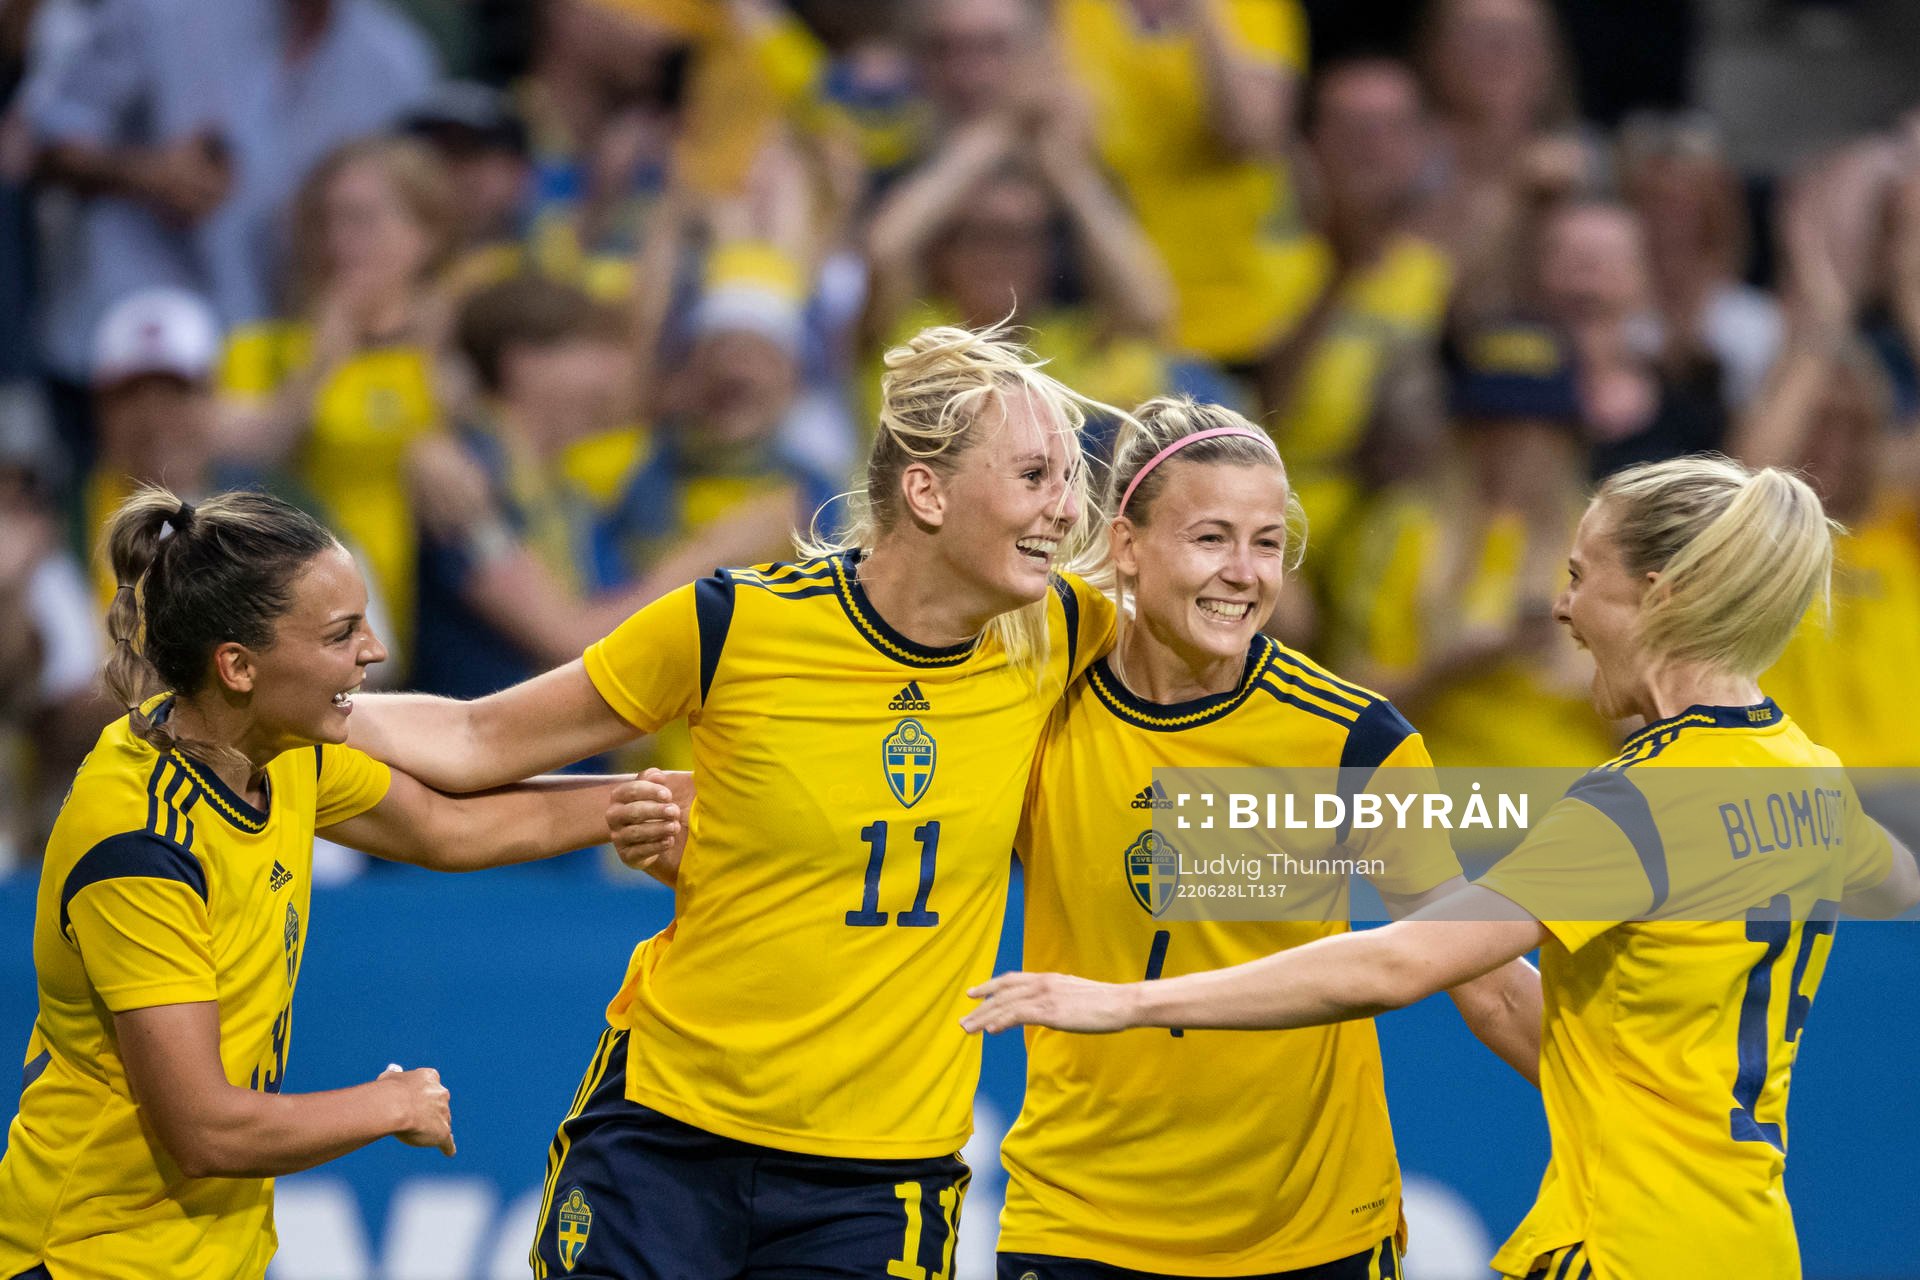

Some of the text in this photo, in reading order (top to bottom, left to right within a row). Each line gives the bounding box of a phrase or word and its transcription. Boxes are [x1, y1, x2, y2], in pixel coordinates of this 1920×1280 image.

[888, 699, 930, 711] adidas
[892, 746, 926, 754] SVERIGE
[1131, 797, 1173, 810] adidas
[270, 871, 293, 893] adidas
[845, 820, 940, 927] 11
[887, 1182, 956, 1280] 11
